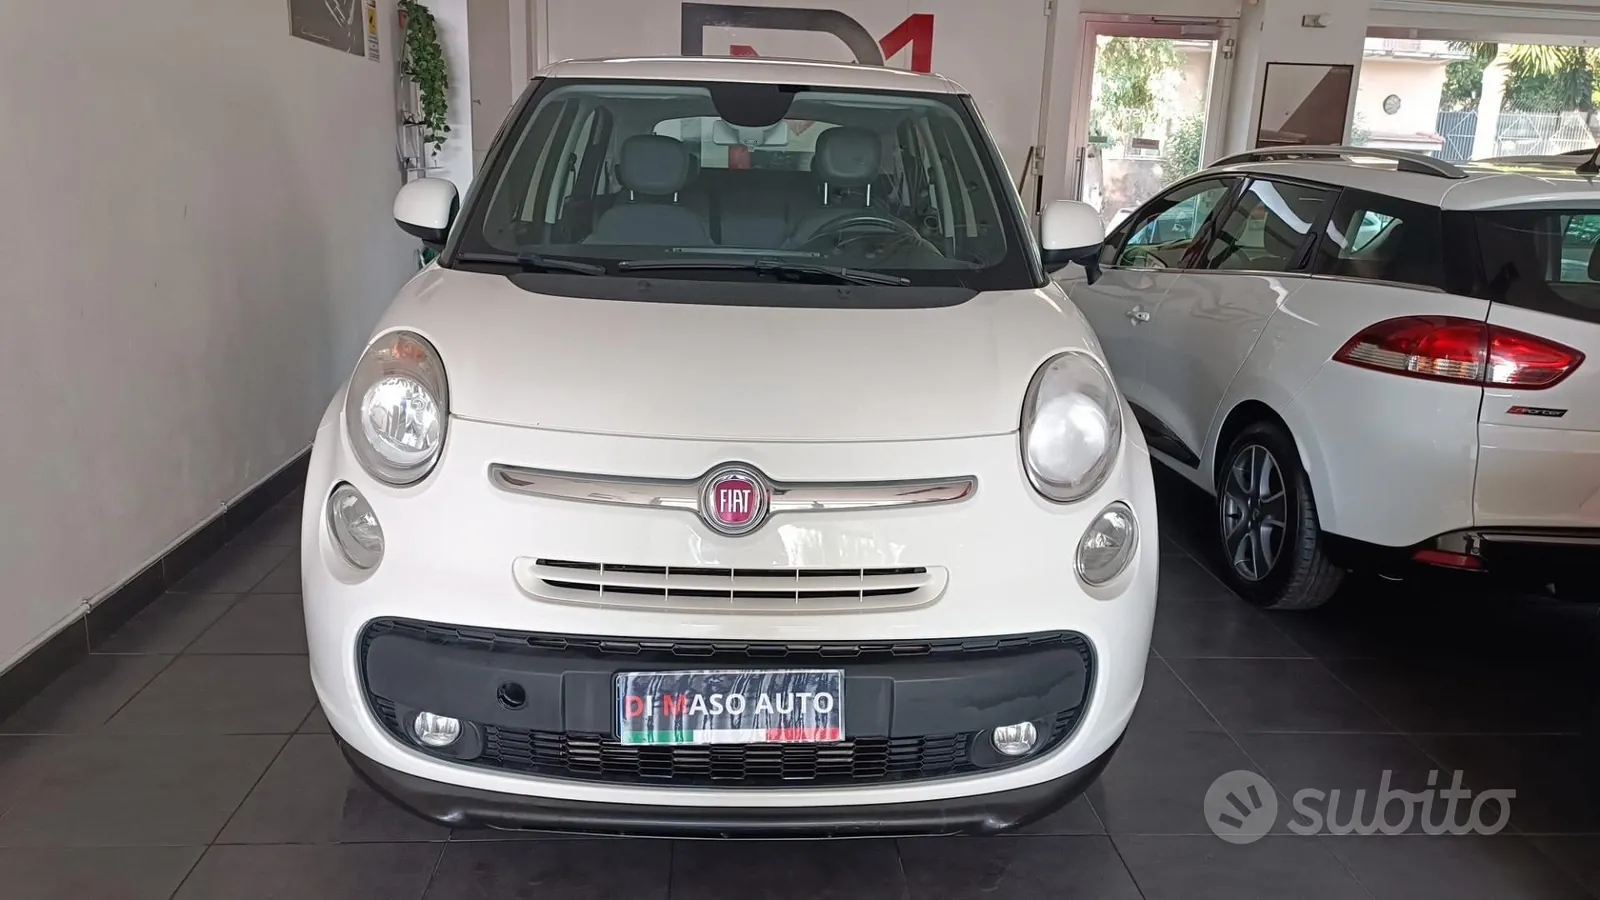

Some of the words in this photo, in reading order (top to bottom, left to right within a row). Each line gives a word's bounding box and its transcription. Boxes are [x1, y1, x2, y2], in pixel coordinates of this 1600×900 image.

[720, 489, 751, 513] FIAT
[625, 694, 653, 717] DI
[662, 692, 746, 716] MASO
[755, 692, 834, 714] AUTO
